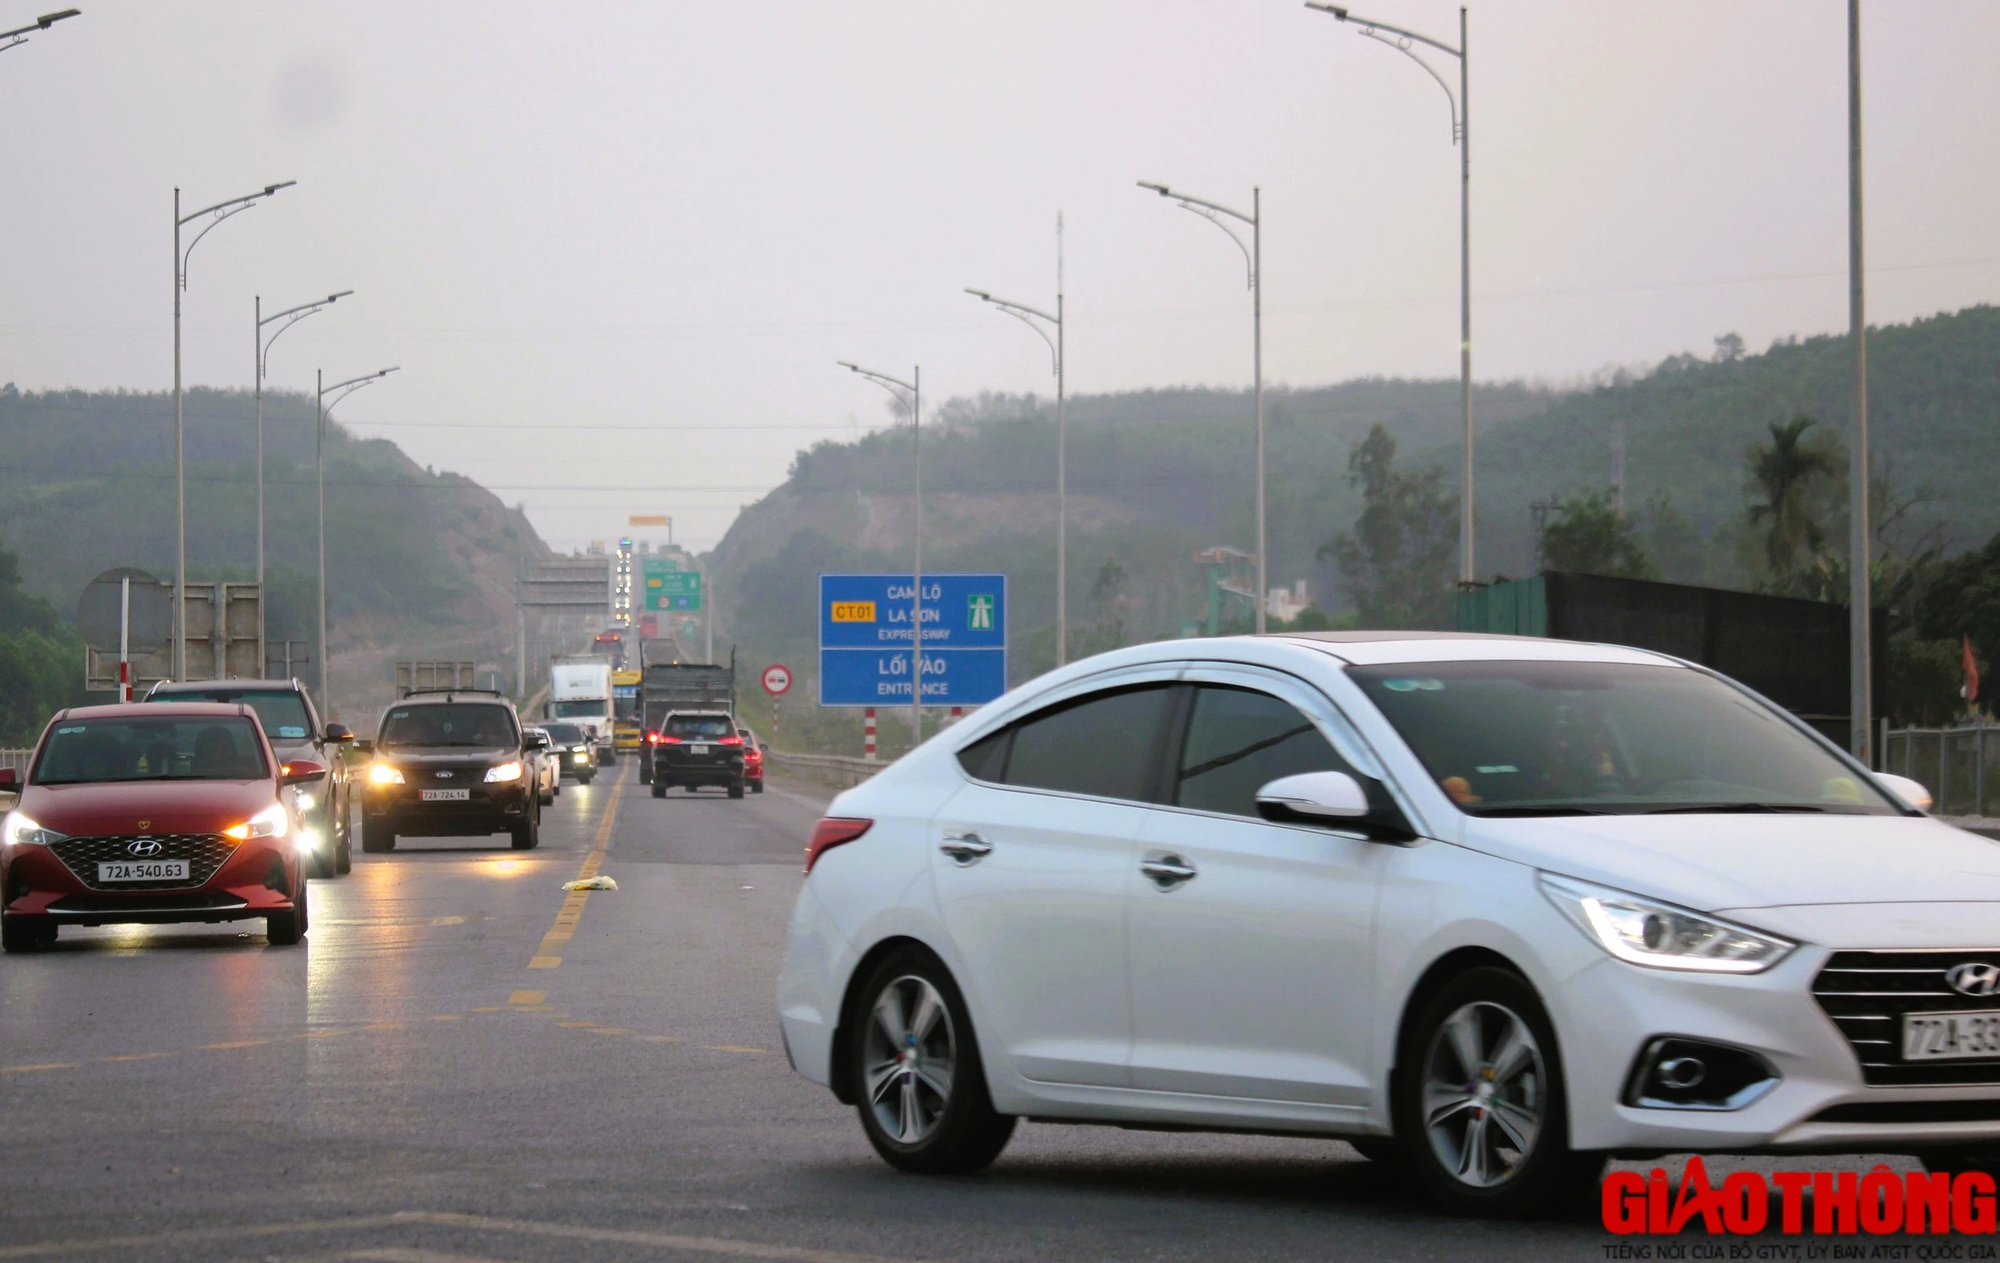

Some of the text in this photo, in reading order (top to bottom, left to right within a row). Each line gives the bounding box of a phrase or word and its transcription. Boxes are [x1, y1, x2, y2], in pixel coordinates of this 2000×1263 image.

[887, 583, 942, 602] CAM LỘ
[888, 610, 907, 622] LA
[878, 629, 950, 640] EXPRESWAY
[879, 654, 907, 675] LỐI
[877, 683, 948, 695] ENTRNCE
[106, 864, 182, 878] 72A-540.63
